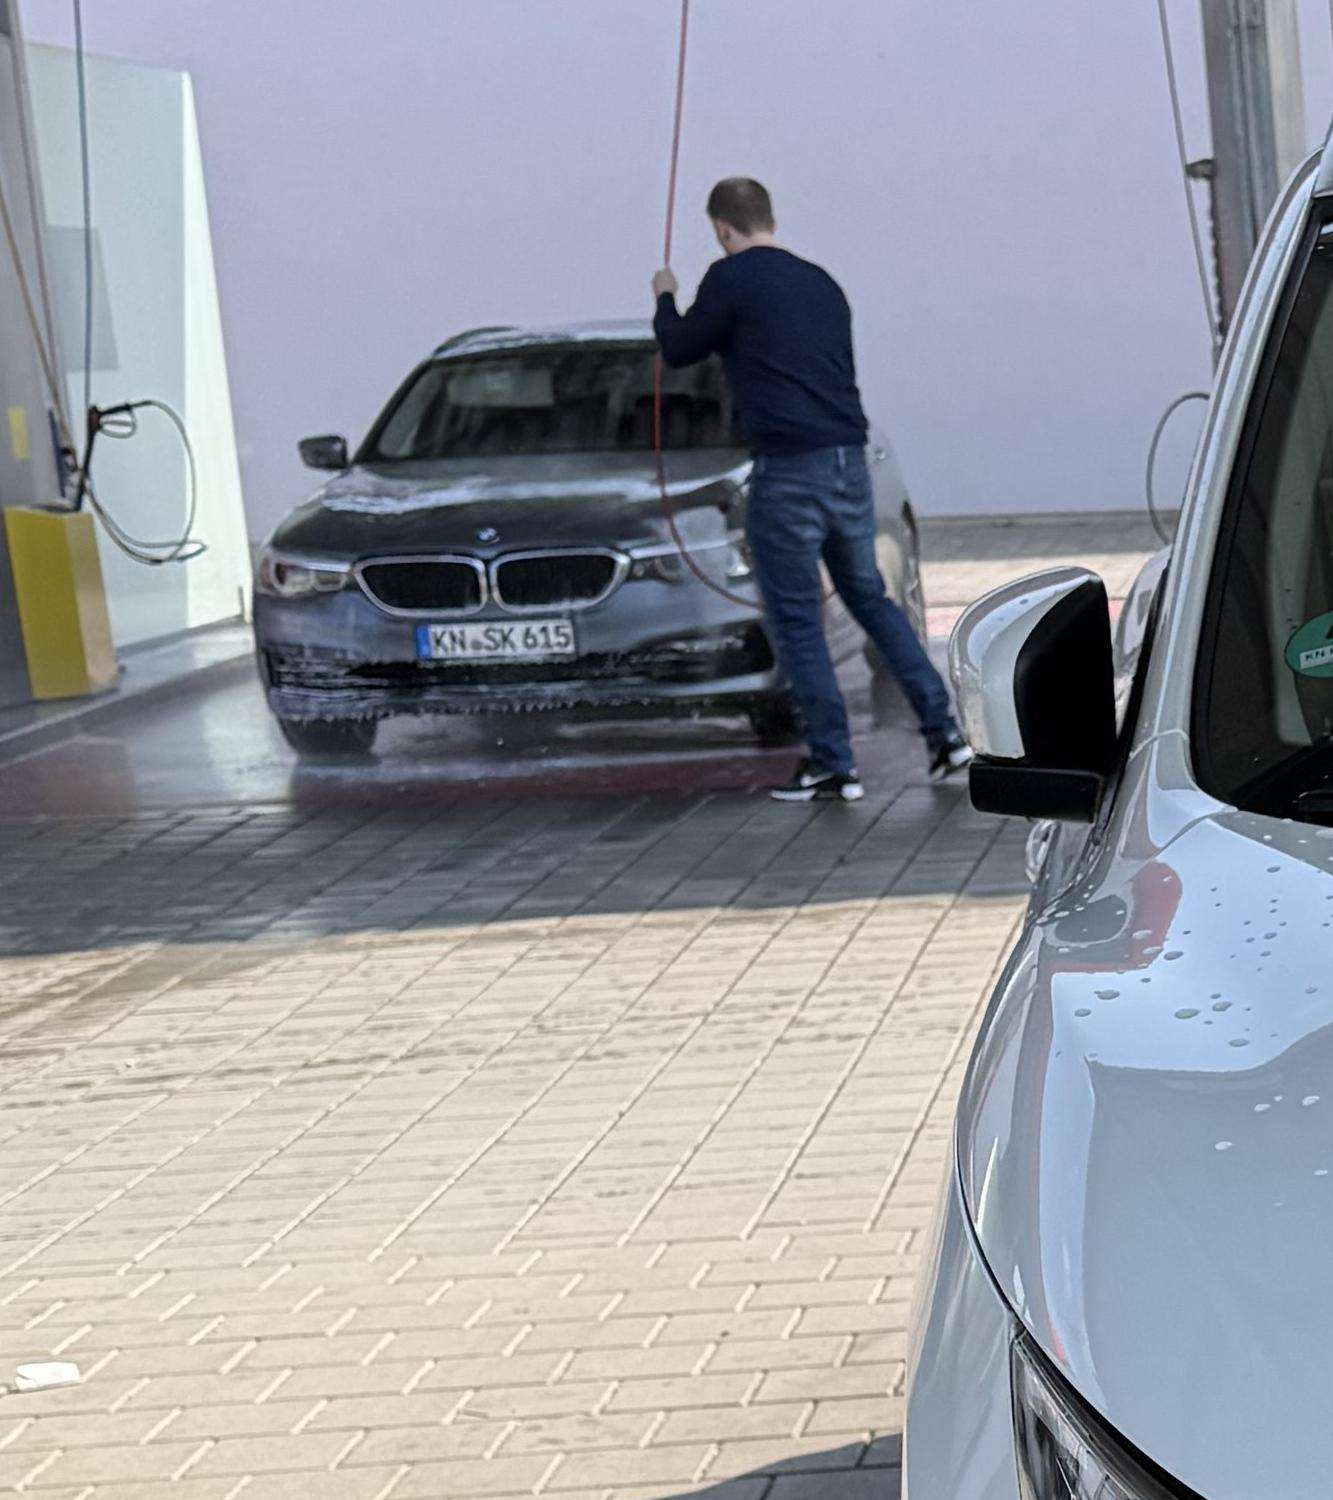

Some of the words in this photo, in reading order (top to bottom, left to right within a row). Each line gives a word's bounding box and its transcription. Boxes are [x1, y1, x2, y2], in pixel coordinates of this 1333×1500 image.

[432, 628, 466, 653] KN
[483, 627, 516, 652] SK
[522, 625, 573, 649] 615
